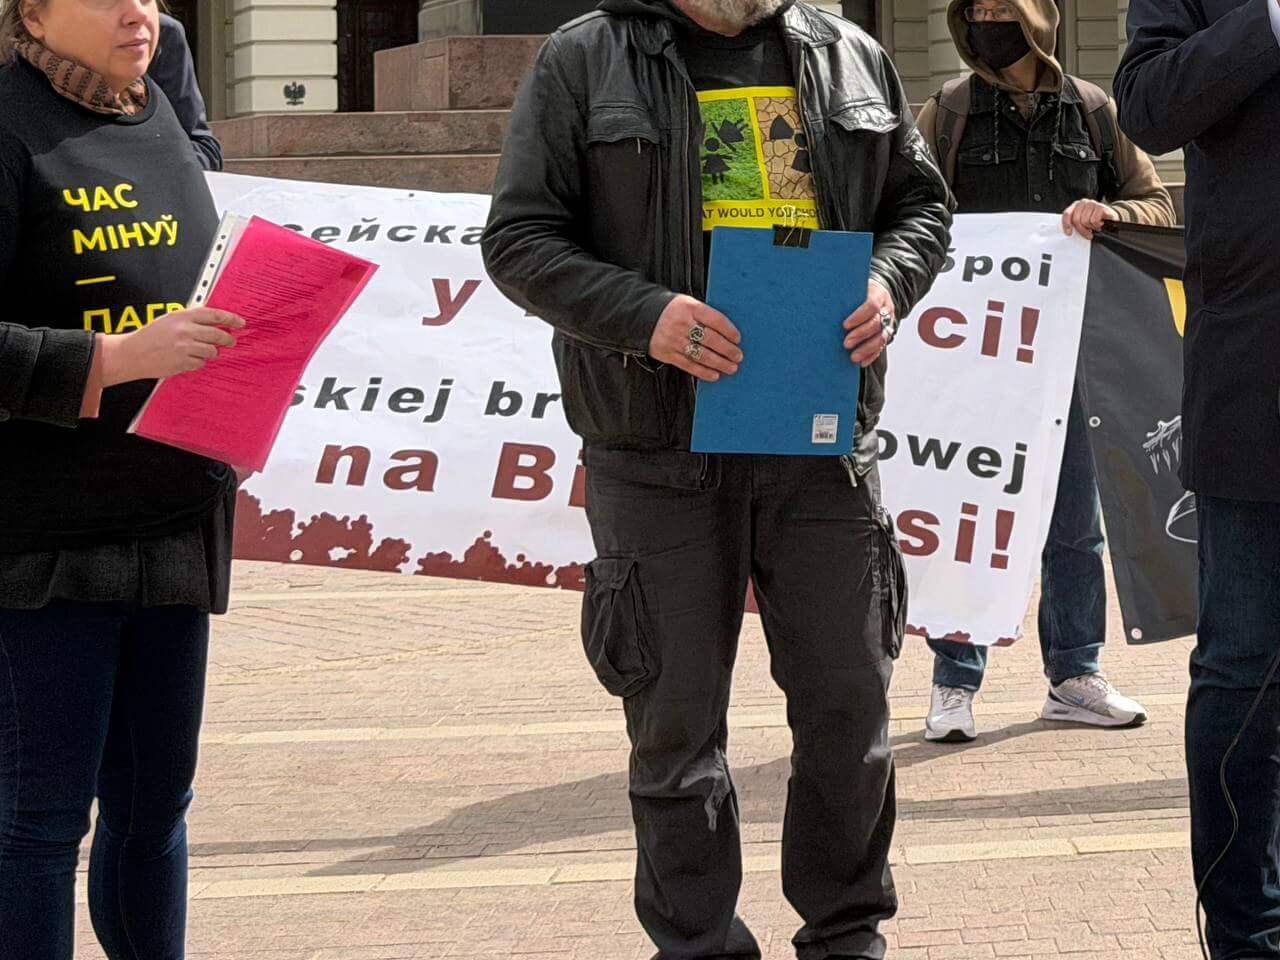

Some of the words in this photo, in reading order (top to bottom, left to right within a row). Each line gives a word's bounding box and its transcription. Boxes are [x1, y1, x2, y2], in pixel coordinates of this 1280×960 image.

[62, 183, 138, 212] ЧАС
[718, 208, 765, 218] WOULD
[768, 206, 793, 218] YOU
[72, 214, 178, 255] МІНУЎ
[282, 217, 486, 246] ейска
[422, 278, 483, 326] у
[484, 381, 561, 419] br
[315, 444, 439, 492] na
[896, 502, 1015, 570] si!
